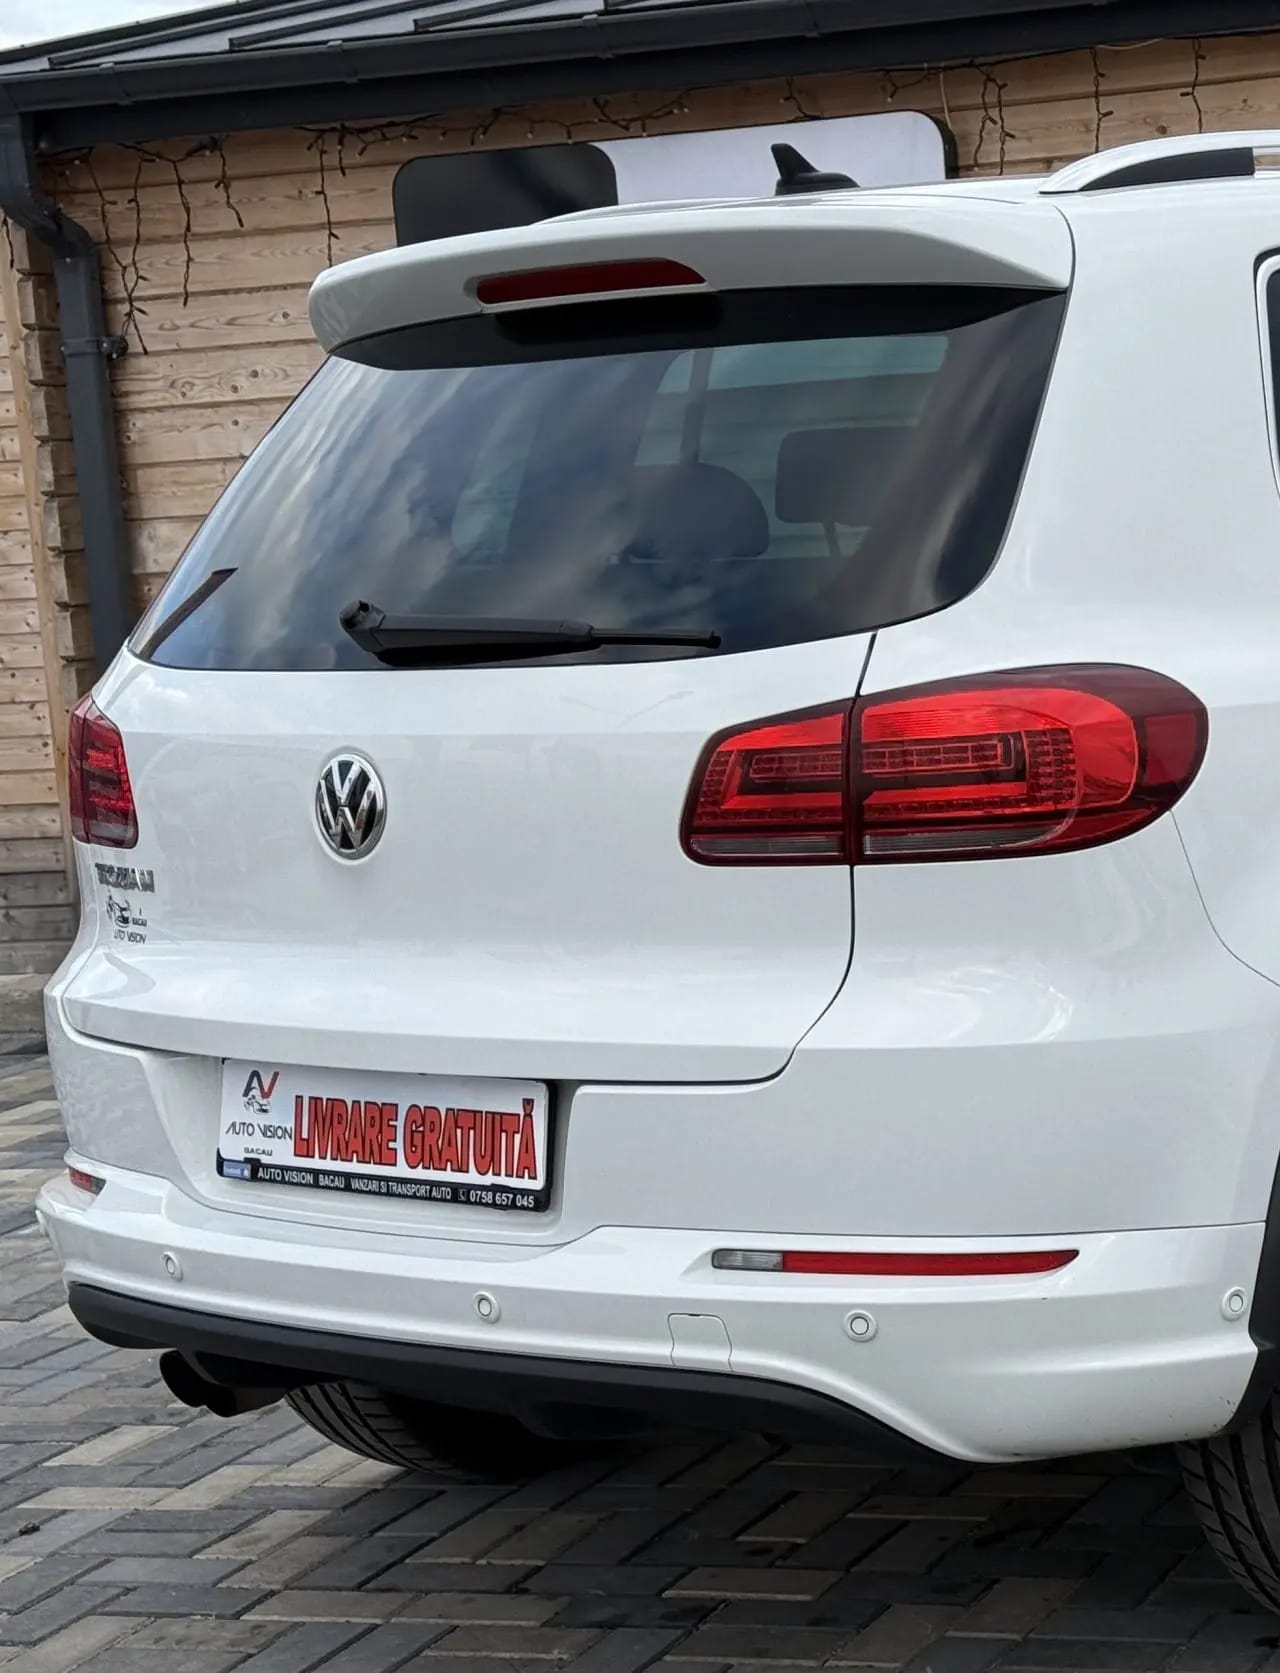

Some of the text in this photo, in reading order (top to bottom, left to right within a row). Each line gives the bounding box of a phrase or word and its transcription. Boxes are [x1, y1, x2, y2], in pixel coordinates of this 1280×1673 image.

[225, 1121, 292, 1142] AUTO VISION
[294, 1095, 537, 1179] LIVRARE GRATUITĂ
[244, 1147, 273, 1157] BACAU
[257, 1167, 282, 1181] AUTO
[283, 1170, 314, 1185] VISION
[318, 1174, 345, 1189] BACAU
[350, 1178, 379, 1193] VANZARI
[388, 1183, 431, 1199] TRANSPORT
[431, 1187, 452, 1200] AUTO
[469, 1190, 493, 1204] 0758
[495, 1193, 514, 1206] 657
[515, 1195, 535, 1208] 045
